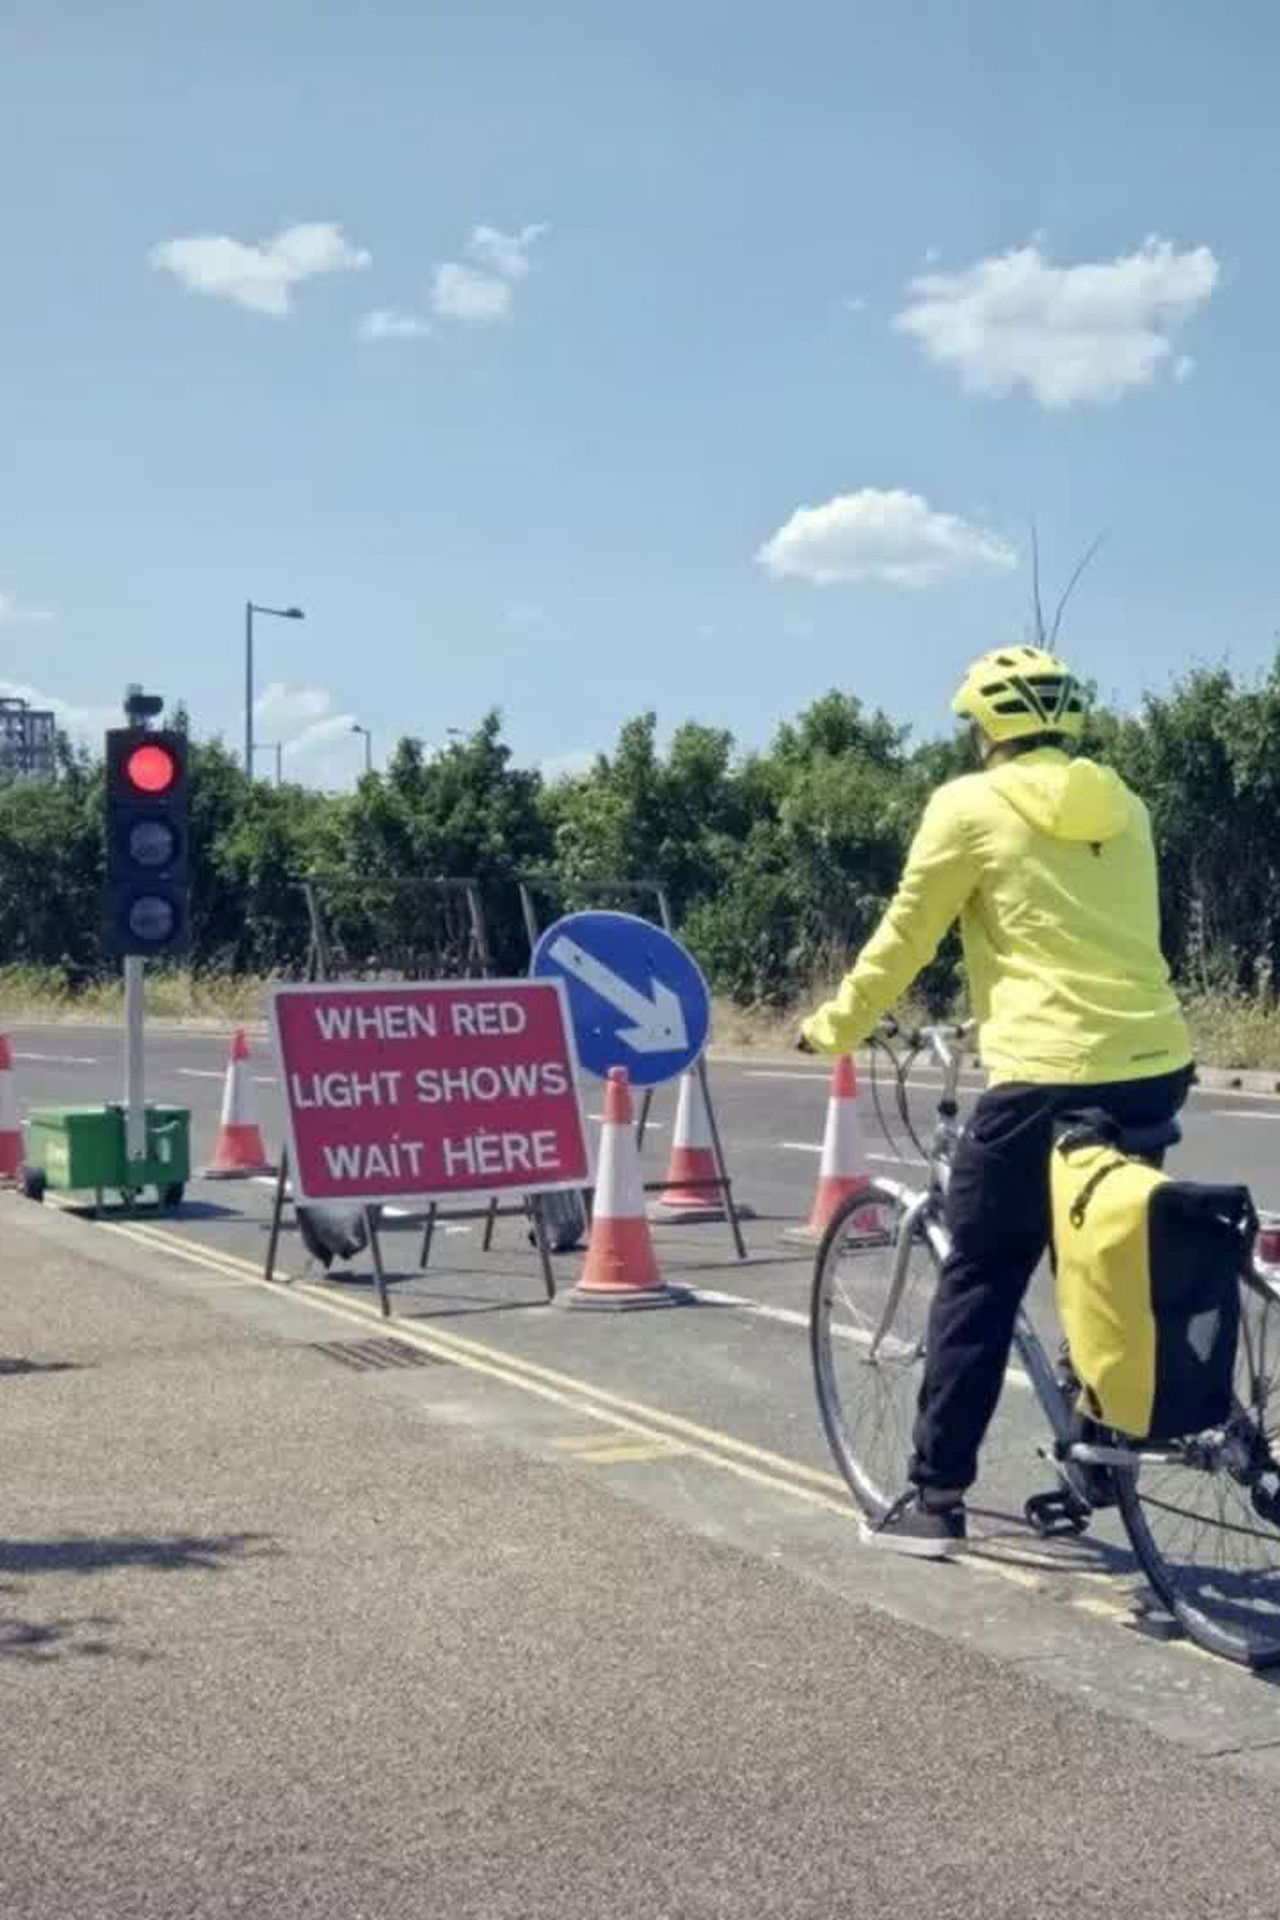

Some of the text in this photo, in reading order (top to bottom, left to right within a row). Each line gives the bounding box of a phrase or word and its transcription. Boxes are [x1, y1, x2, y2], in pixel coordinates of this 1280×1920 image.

[315, 1001, 526, 1039] WHEN RED
[292, 1063, 568, 1108] LIGHT SHOWS
[323, 1130, 560, 1180] WAIT HERE
